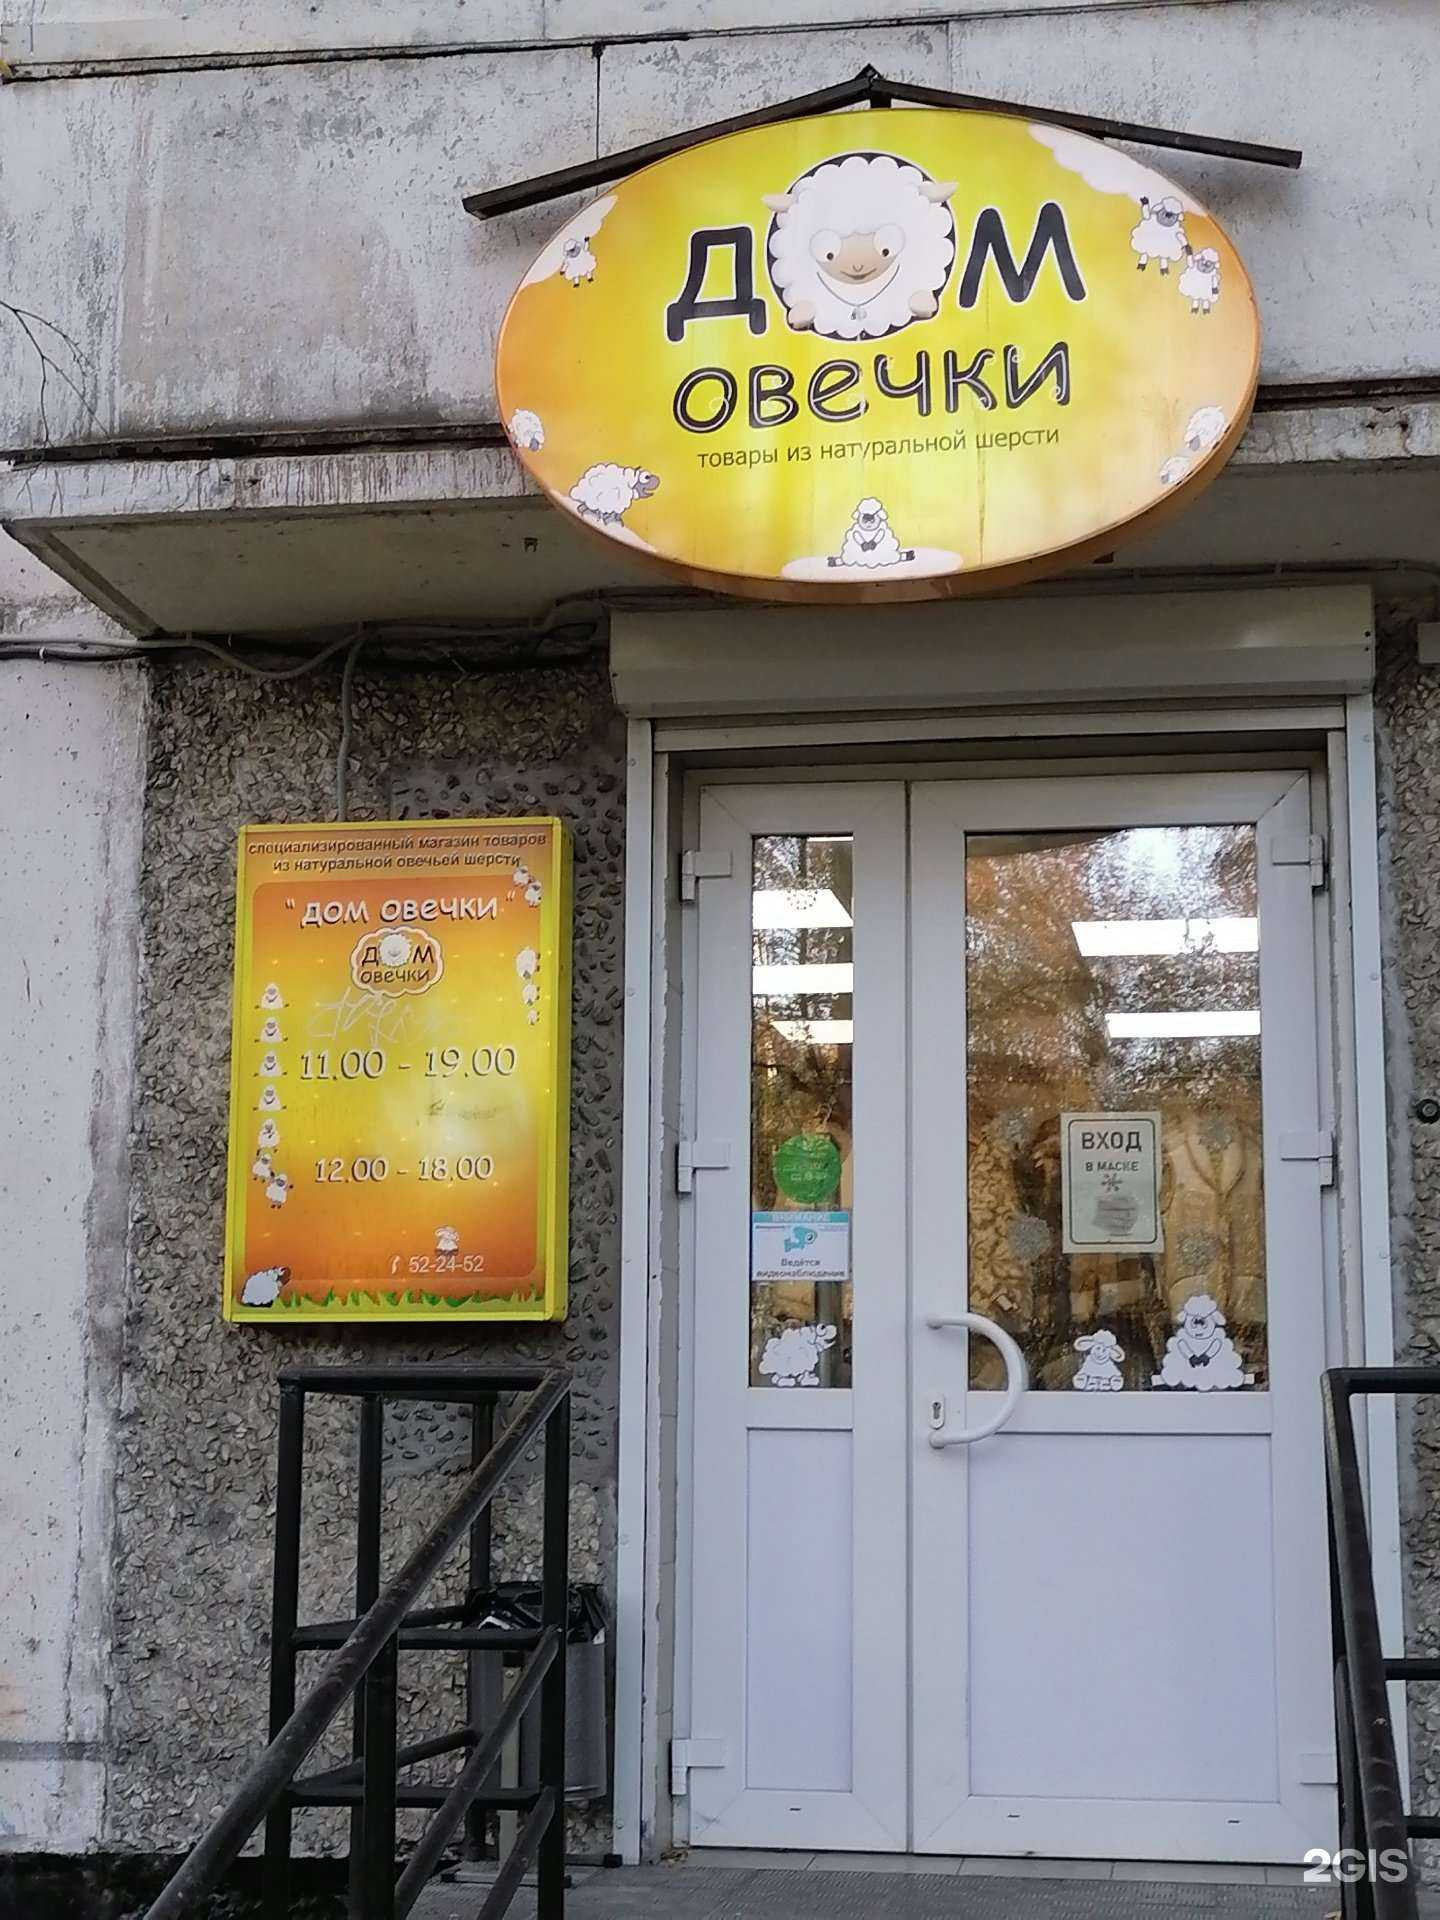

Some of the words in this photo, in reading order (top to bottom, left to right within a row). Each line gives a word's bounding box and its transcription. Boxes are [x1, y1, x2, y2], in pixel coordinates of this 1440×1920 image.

[698, 446, 778, 469] товары
[787, 444, 812, 462] из
[820, 430, 966, 461] натуральной
[976, 427, 1060, 452] шерсти
[248, 835, 414, 855] специализированный
[418, 836, 480, 849] магазин
[484, 833, 547, 849] товаров
[273, 859, 290, 872] из
[294, 855, 392, 873] натуральной
[396, 854, 460, 868] овечьей
[463, 852, 521, 868] шерсти
[300, 1049, 386, 1081] 11.00
[424, 1046, 518, 1079] 19.00
[1081, 1131, 1143, 1152] ВХОД
[315, 1157, 390, 1183] 12.00
[418, 1155, 494, 1182] 18.00
[1085, 1161, 1094, 1172] В
[1097, 1160, 1140, 1172] МАСКЕ
[408, 1255, 485, 1273] 52-24-52
